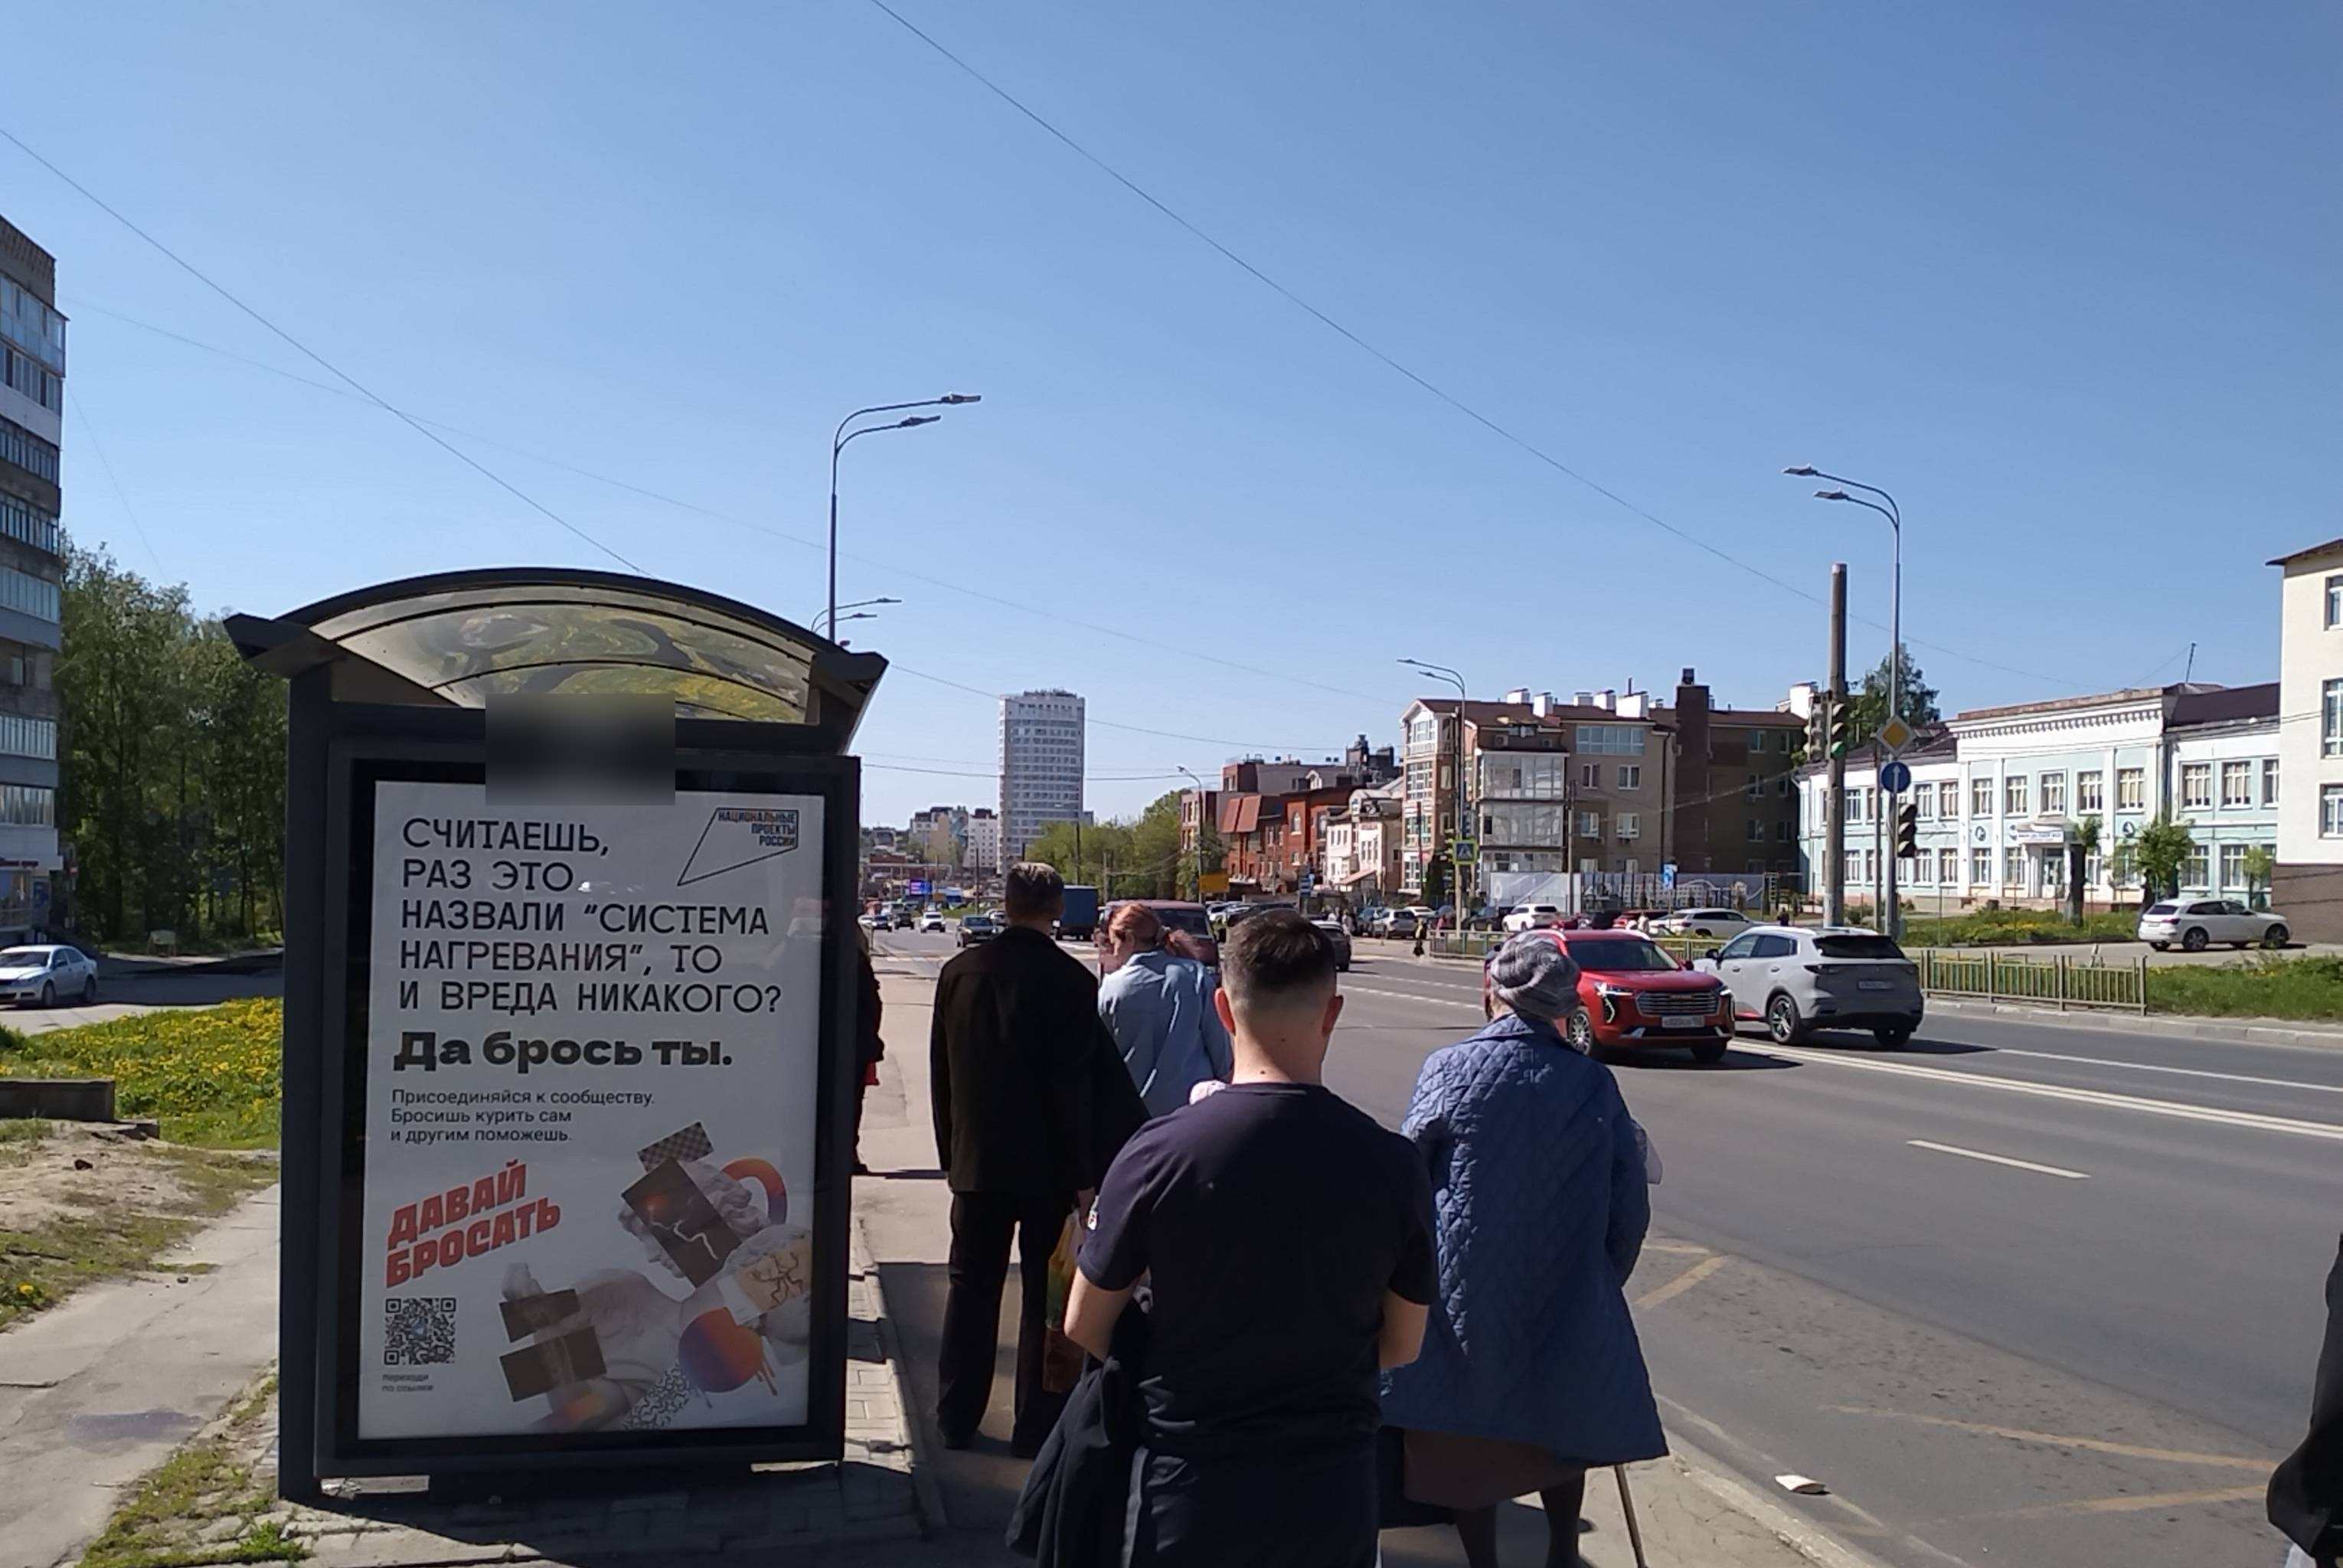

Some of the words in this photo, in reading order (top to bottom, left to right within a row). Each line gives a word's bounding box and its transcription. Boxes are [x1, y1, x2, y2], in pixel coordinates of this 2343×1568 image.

[718, 811, 795, 822] НАЦИОНАЛЬНЫЕ
[751, 823, 796, 835] ПРОЕКТЫ
[403, 818, 609, 856] СЧИТАЕШЬ,
[759, 835, 795, 846] РОССИИ
[403, 858, 472, 890] РАЗ
[492, 861, 573, 892] ЭТО
[402, 899, 564, 932] НАЗВАЛИ
[669, 944, 722, 974] ТО
[400, 980, 419, 1010] И
[441, 981, 557, 1017] ВРЕДА
[577, 982, 781, 1013] НИКАКОГО?
[393, 1031, 472, 1072] Да
[482, 1031, 642, 1074] брось
[651, 1040, 733, 1066] ты.
[392, 1089, 531, 1106] Присоединяйся
[536, 1093, 546, 1103] к
[550, 1089, 655, 1107] сообществу.
[391, 1107, 471, 1125] Бросишь
[475, 1110, 534, 1125] курить
[539, 1110, 572, 1122] сам
[390, 1130, 401, 1142] и
[404, 1130, 469, 1145] другим
[475, 1129, 573, 1142] поможешь.
[387, 1158, 527, 1251] ДАВАЙ
[386, 1197, 560, 1289] БРОСАТЬ
